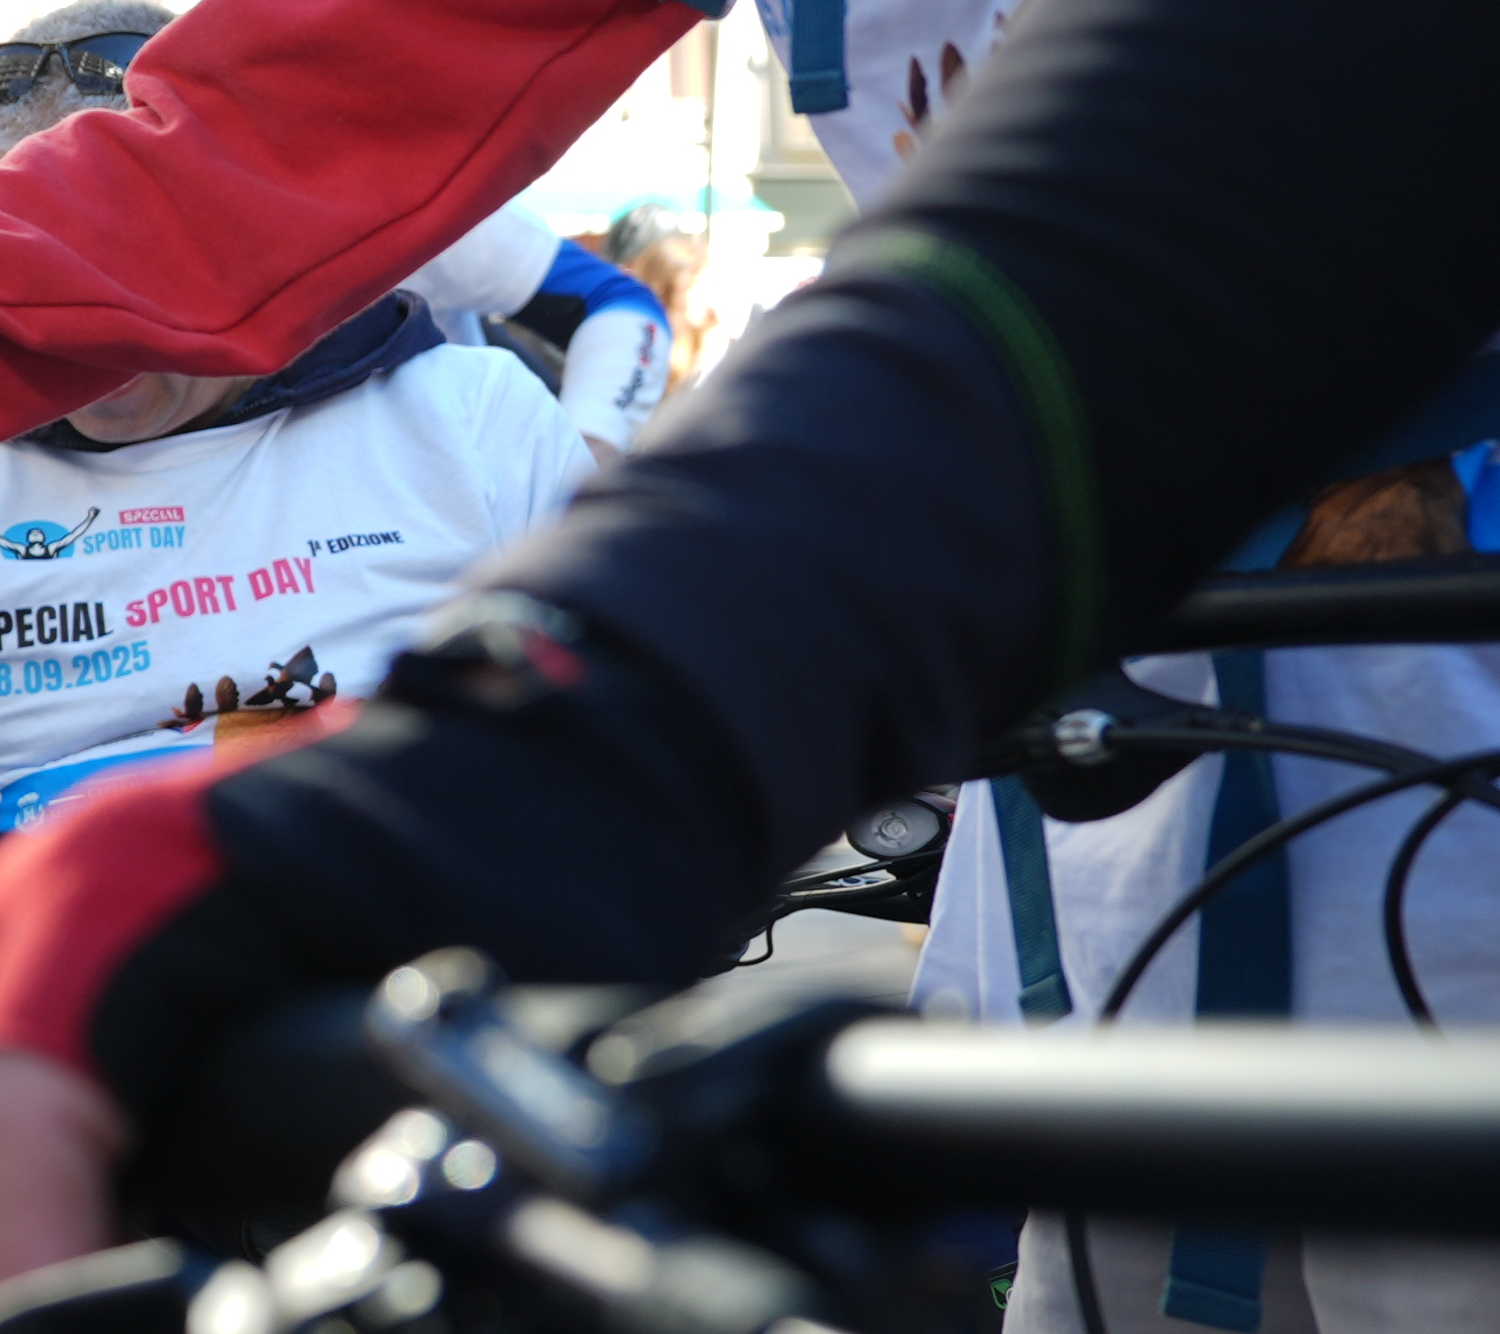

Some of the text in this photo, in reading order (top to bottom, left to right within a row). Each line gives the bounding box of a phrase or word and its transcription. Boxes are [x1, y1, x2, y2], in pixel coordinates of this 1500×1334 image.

[122, 509, 182, 524] SPECIAL
[82, 524, 186, 555] SPORT DAY
[325, 530, 405, 555] EDIZIONE
[124, 575, 238, 628] SPORT
[247, 557, 316, 603] DAY
